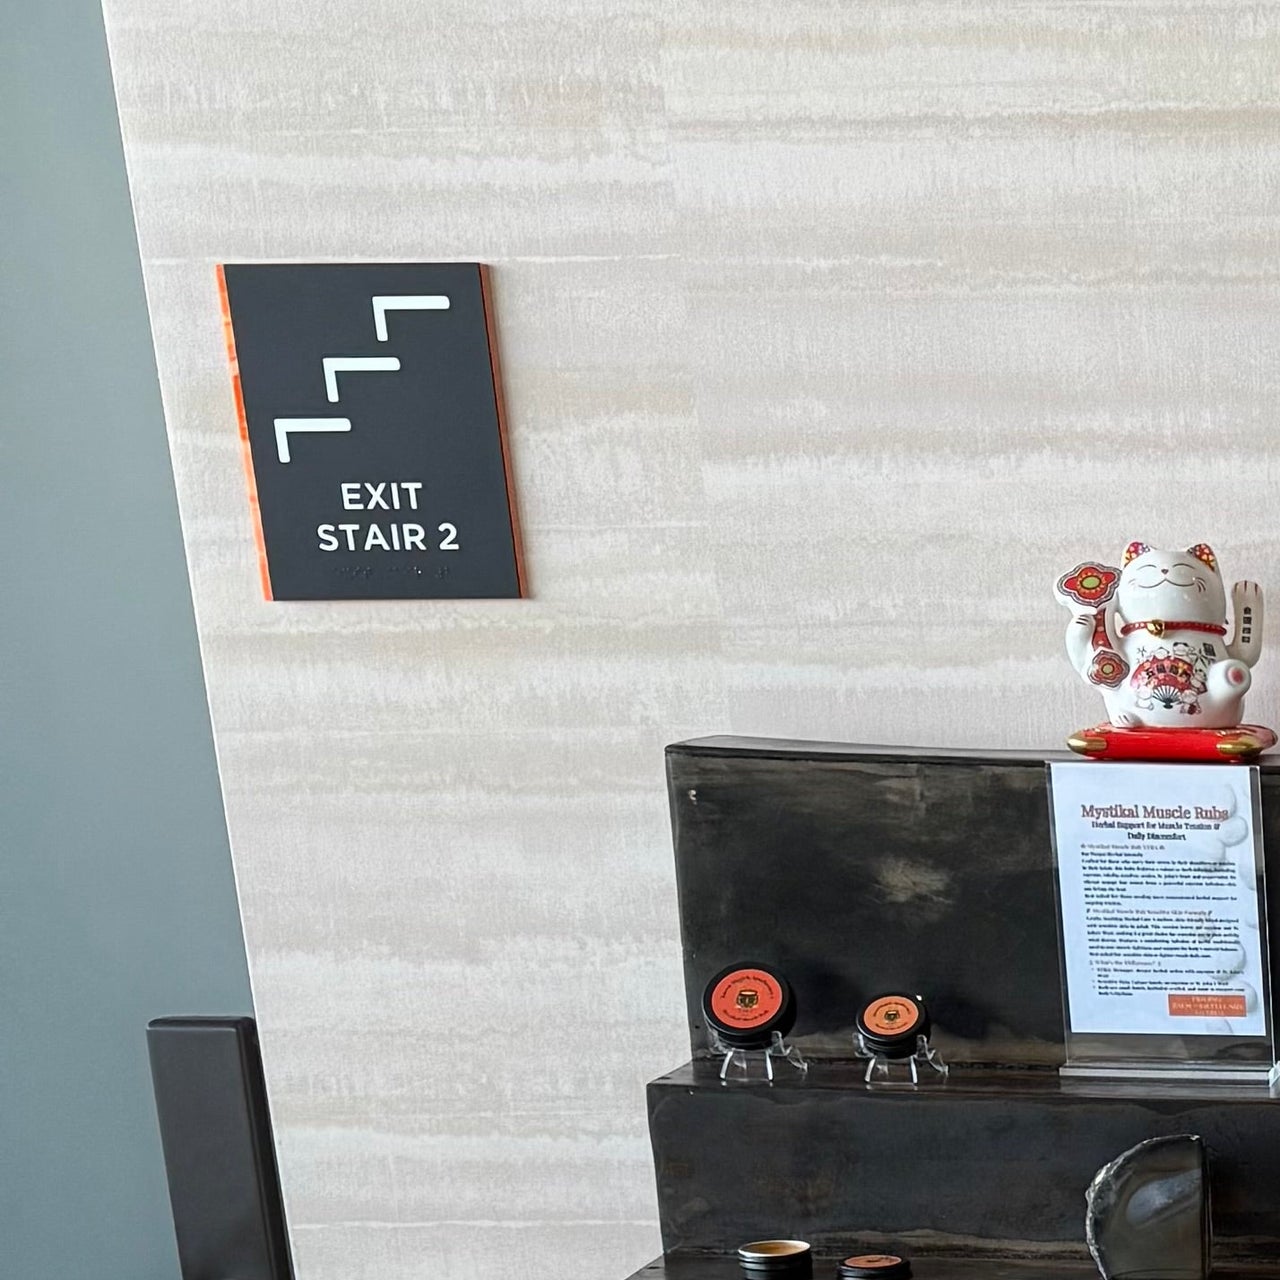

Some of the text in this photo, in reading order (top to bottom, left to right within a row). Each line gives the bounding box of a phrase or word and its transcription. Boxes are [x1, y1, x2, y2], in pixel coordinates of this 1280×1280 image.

[341, 482, 422, 510] EXIT
[317, 522, 460, 551] STAIR 2
[1081, 804, 1229, 820] Mystikal Muscle Rubs
